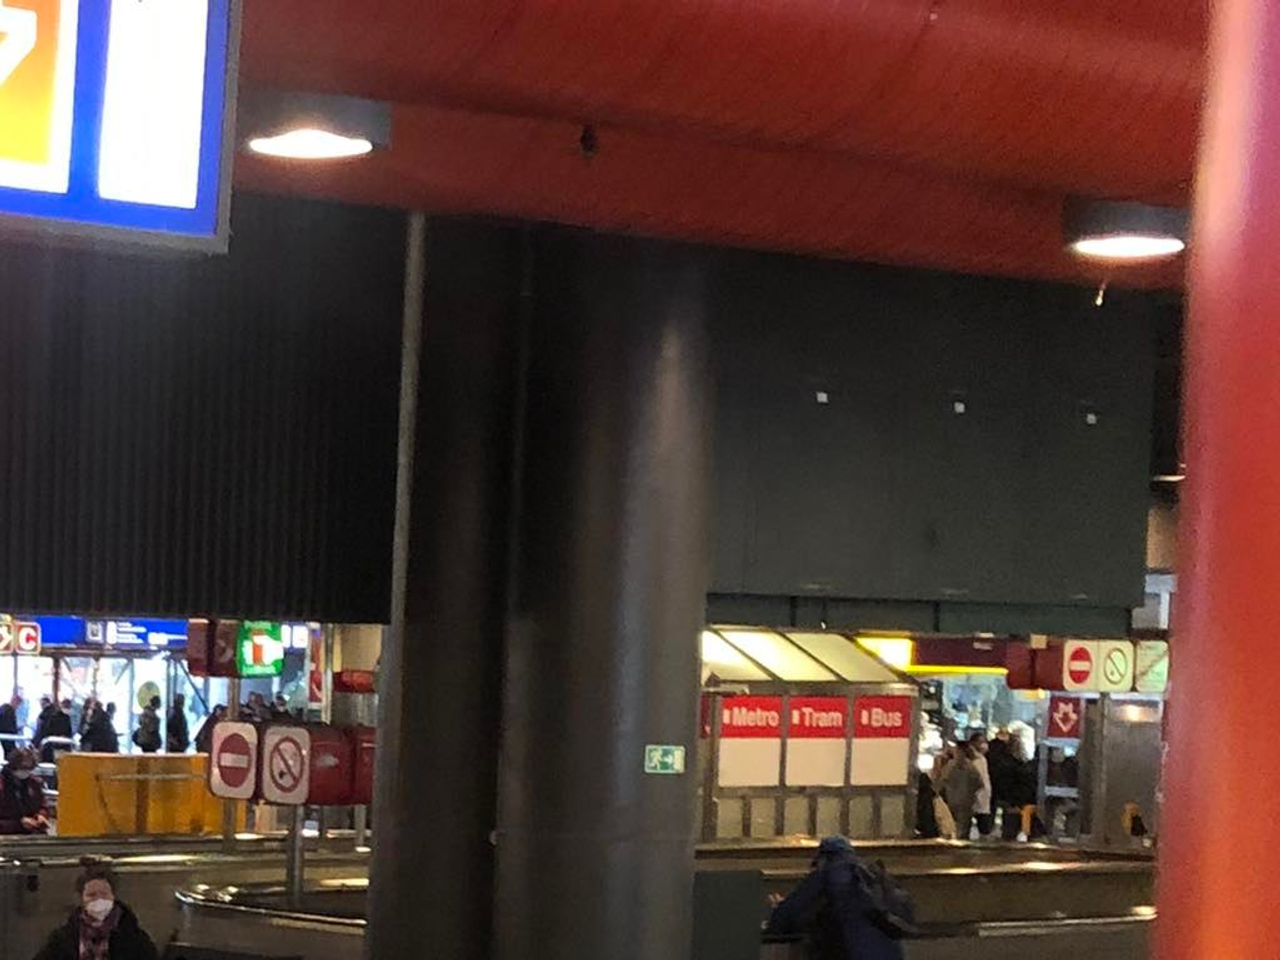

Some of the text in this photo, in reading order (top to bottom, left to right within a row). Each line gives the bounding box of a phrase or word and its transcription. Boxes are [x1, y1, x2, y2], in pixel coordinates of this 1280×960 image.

[19, 627, 37, 649] C
[732, 706, 780, 727] Metro
[801, 707, 843, 727] Tram
[871, 707, 902, 727] Bus
